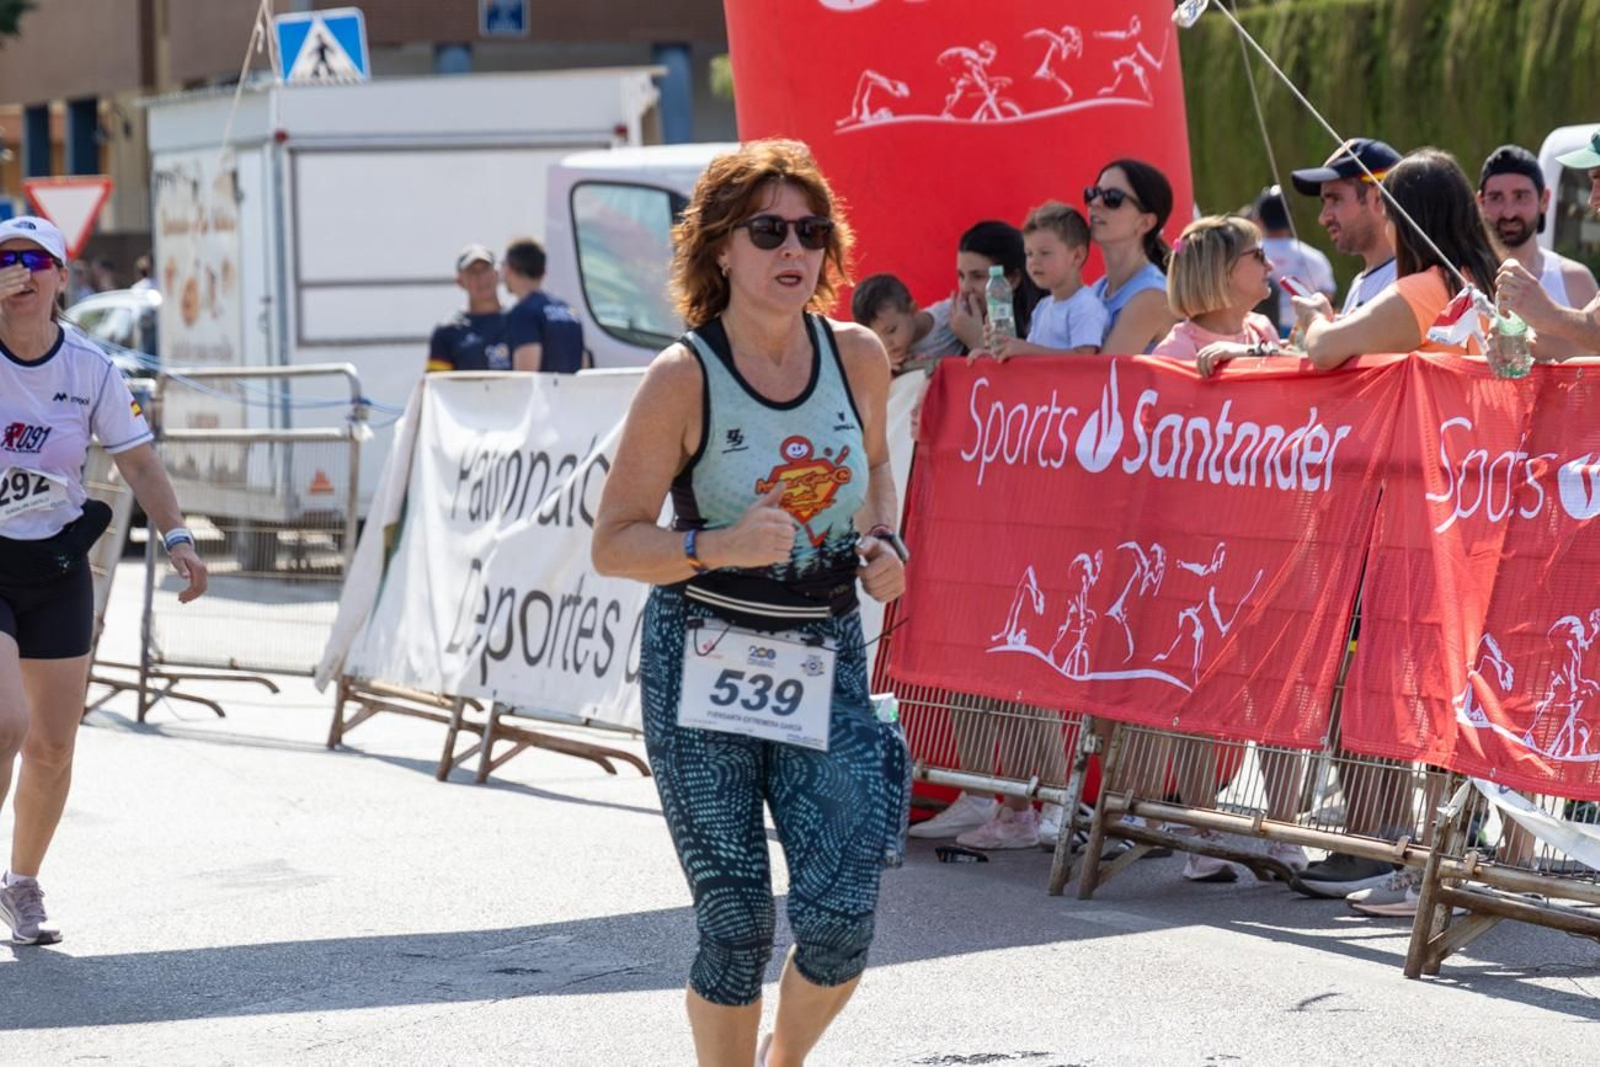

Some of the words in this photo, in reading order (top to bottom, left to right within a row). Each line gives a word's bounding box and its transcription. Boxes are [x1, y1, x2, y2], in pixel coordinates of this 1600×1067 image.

[960, 377, 1078, 485] Sports
[1122, 389, 1352, 492] Santander
[1425, 416, 1558, 534] Spots
[709, 668, 804, 717] 539
